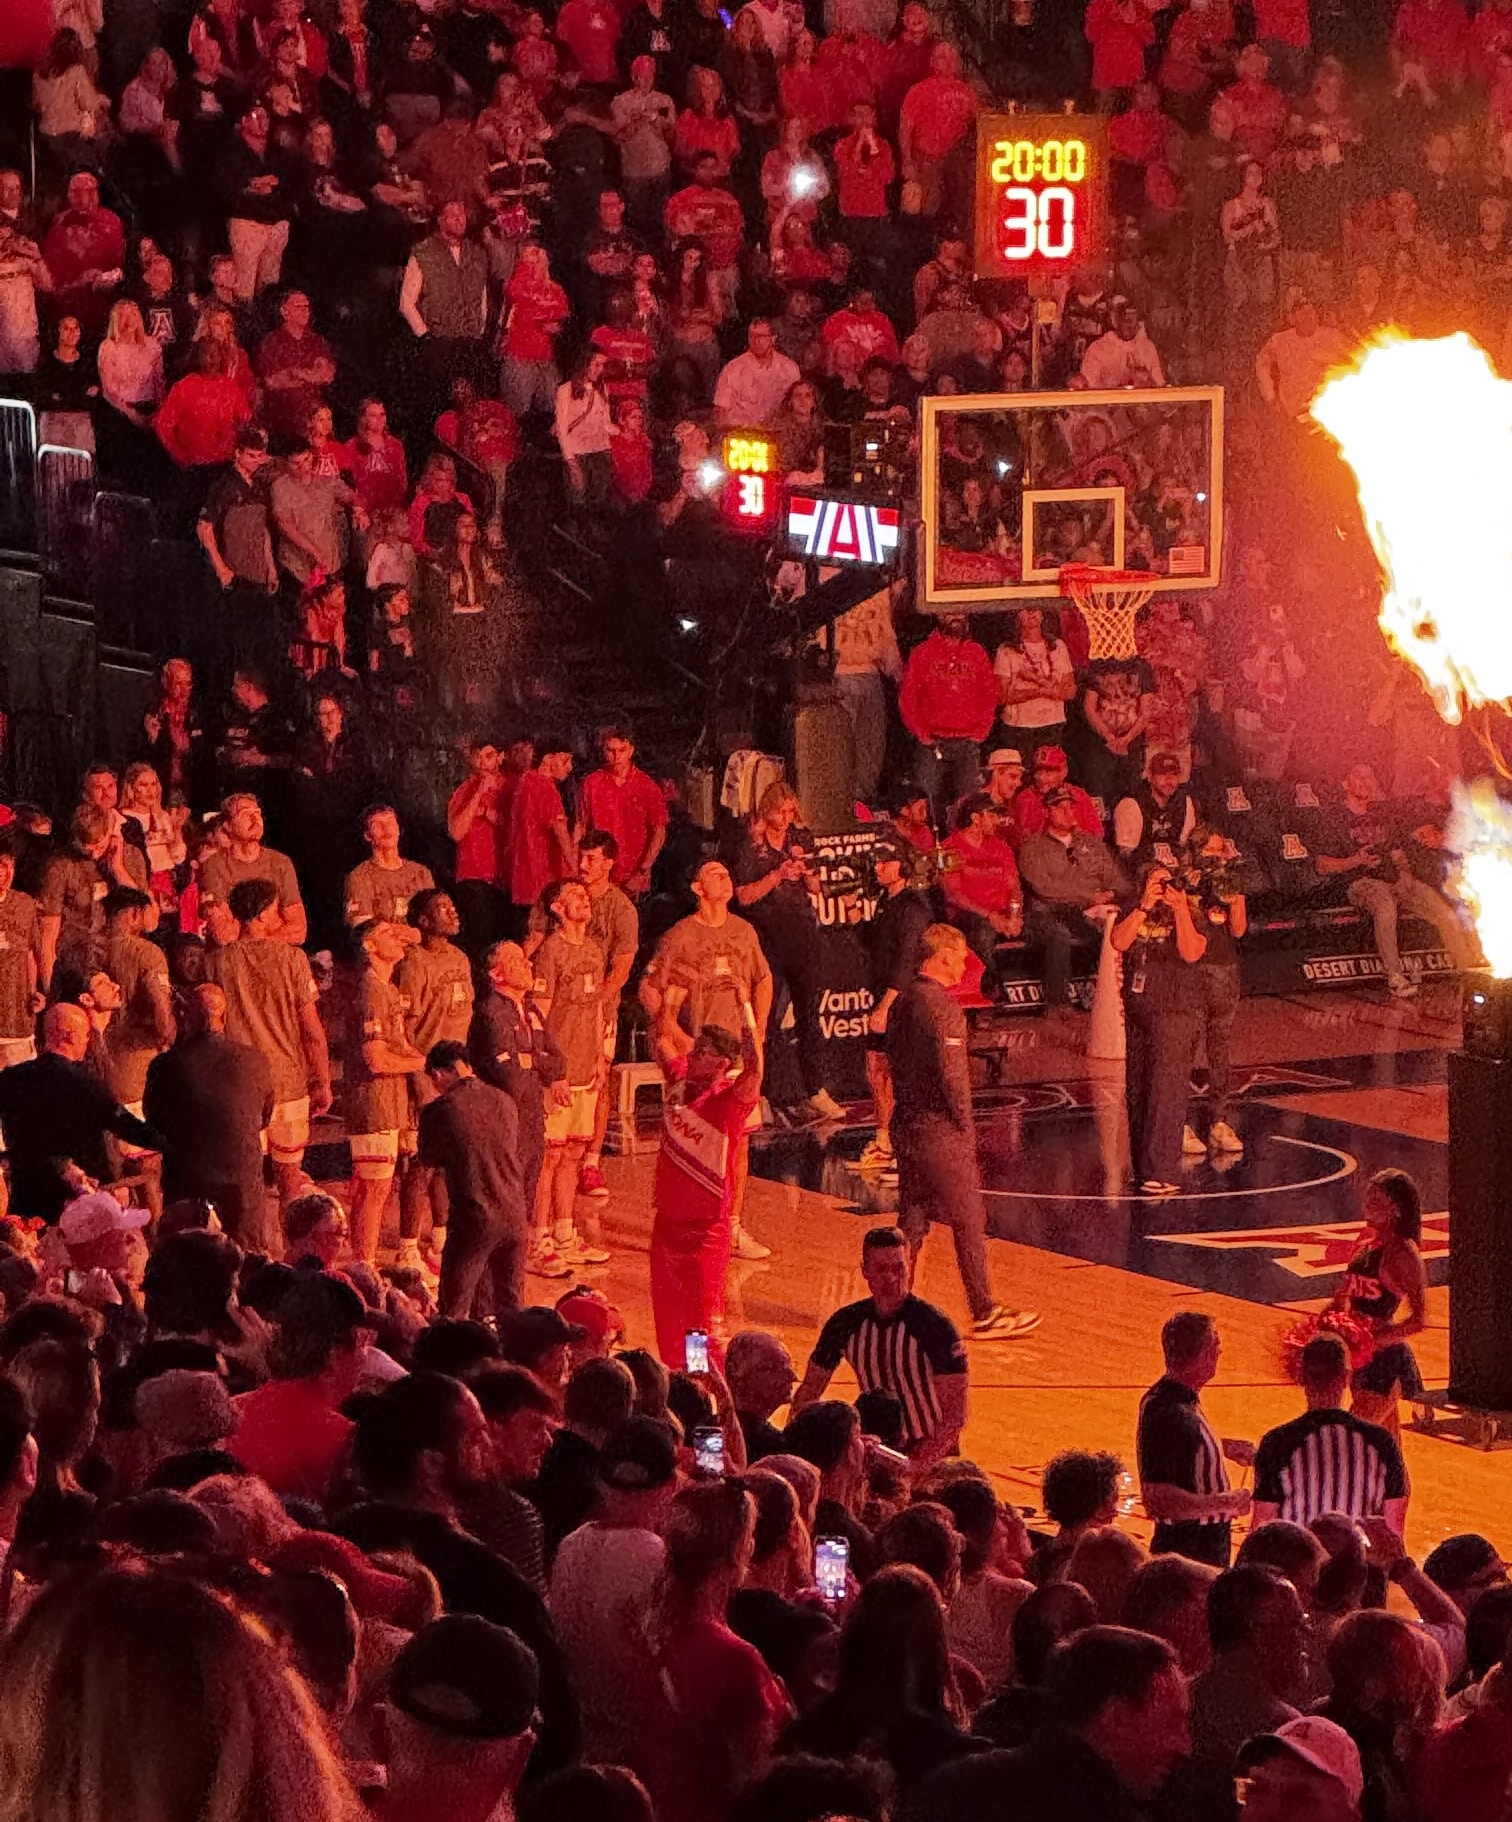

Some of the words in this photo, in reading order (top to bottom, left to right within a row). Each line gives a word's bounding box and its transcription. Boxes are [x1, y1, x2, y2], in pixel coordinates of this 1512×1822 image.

[991, 140, 1086, 183] 20:00
[1004, 187, 1075, 259] 30
[738, 474, 764, 515] 30
[813, 837, 842, 848] ROCK
[1282, 833, 1308, 859] A
[1303, 959, 1357, 979] DESERT
[1345, 1273, 1383, 1300] ATS
